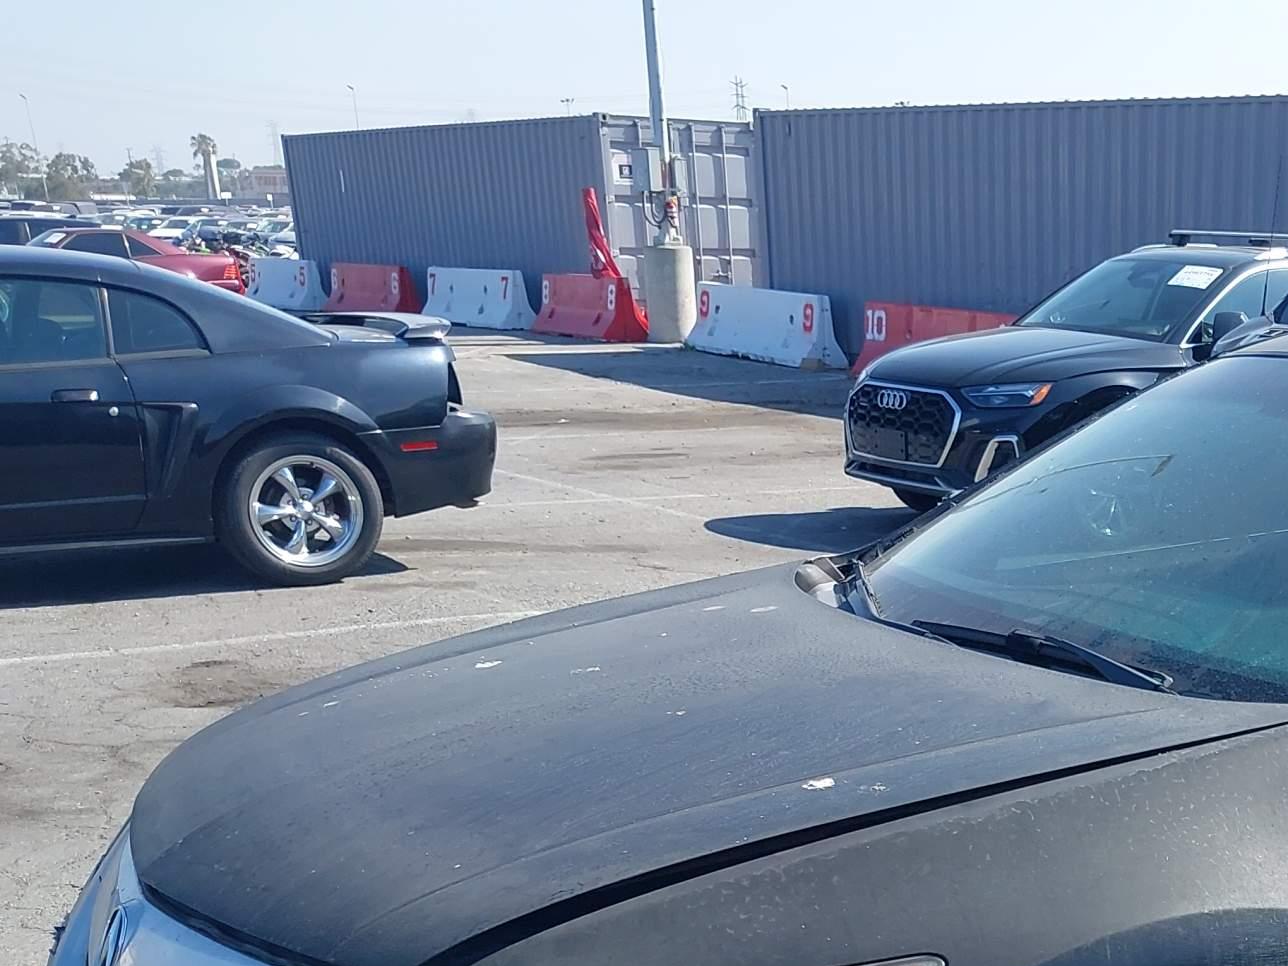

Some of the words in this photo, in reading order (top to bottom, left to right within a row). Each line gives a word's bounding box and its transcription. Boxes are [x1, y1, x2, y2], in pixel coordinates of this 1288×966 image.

[298, 266, 306, 287] 5
[391, 272, 400, 294] 6
[429, 273, 436, 295] 7
[501, 276, 509, 300] 7
[542, 280, 549, 304] 8
[607, 284, 616, 310] 8
[700, 290, 710, 318] 9
[803, 303, 814, 333] 9
[865, 309, 887, 341] 10
